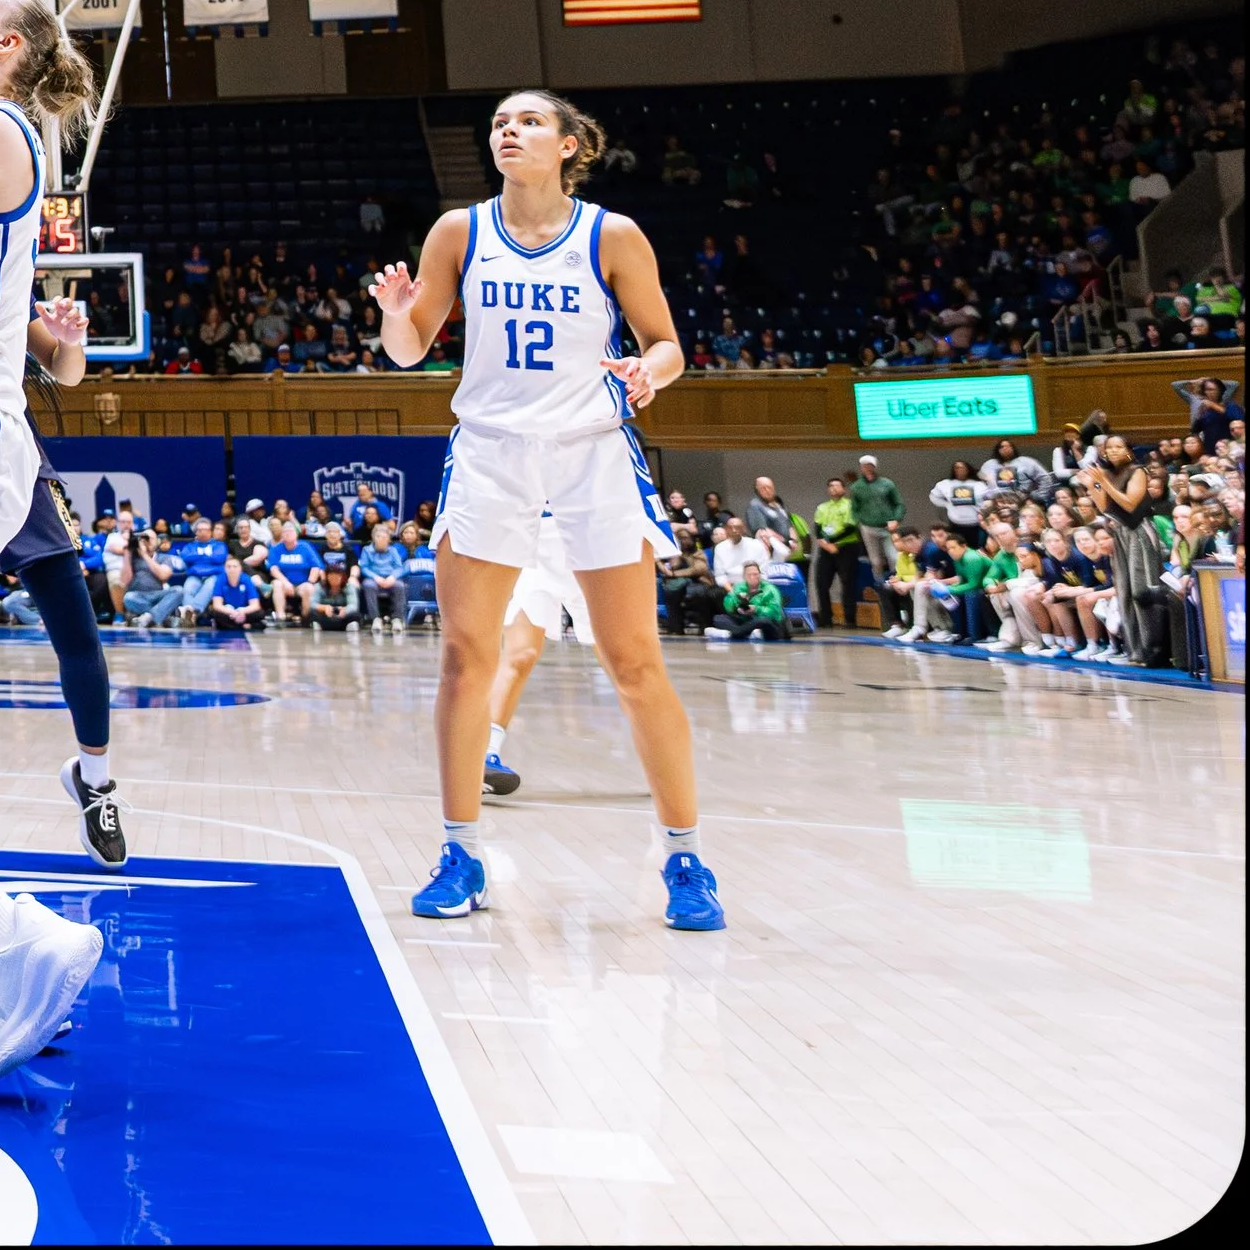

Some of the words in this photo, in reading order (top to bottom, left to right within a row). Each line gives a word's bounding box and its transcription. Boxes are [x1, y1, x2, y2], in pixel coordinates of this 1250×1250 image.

[481, 281, 580, 313] DUKE
[505, 319, 554, 370] 12
[322, 480, 397, 501] SISTEOOD
